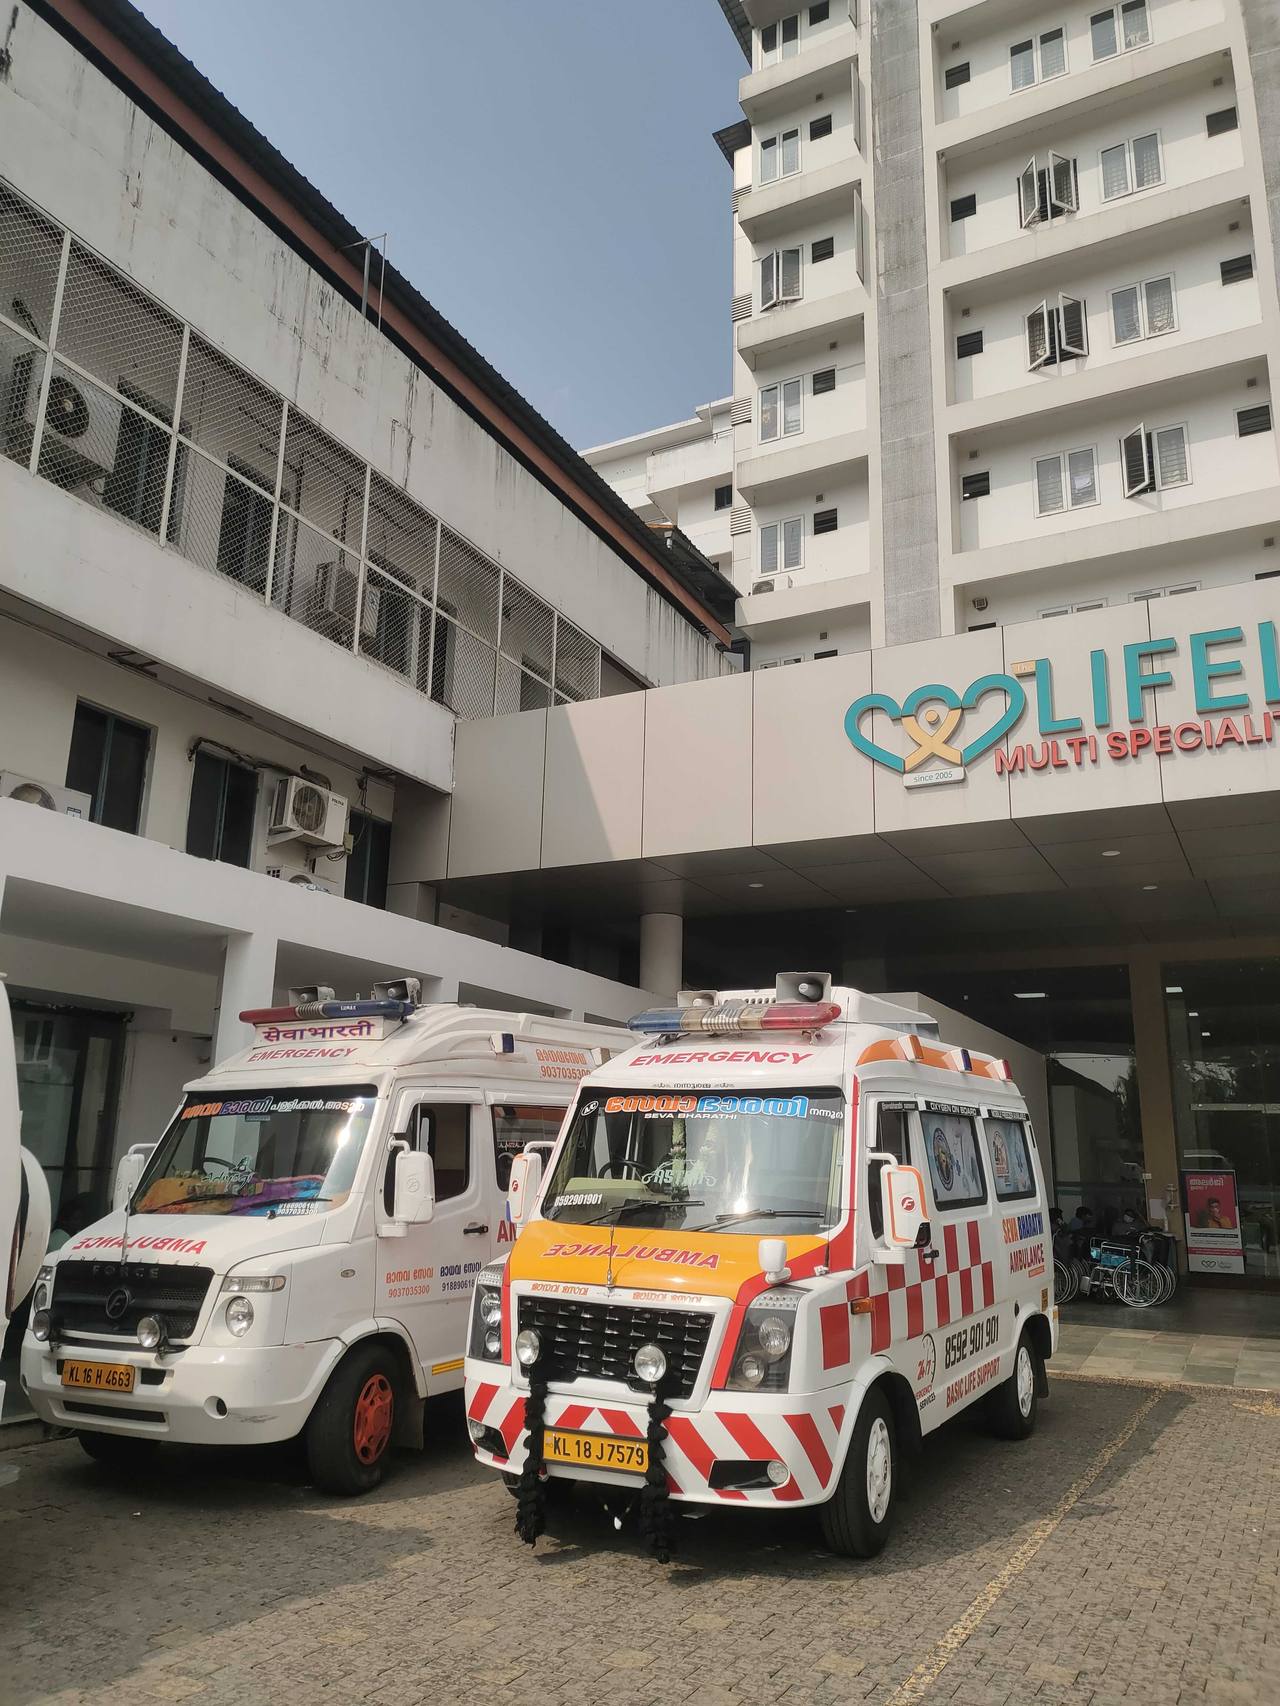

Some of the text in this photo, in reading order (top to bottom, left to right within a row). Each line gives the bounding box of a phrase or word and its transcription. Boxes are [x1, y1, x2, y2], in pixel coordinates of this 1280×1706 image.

[994, 710, 1280, 776] MULTI SPECIALI
[913, 771, 953, 783] since 2005
[247, 1047, 359, 1063] EMERGENCY
[628, 1051, 815, 1067] EMERGENCY
[677, 1112, 738, 1120] BHARATHI
[1009, 1243, 1045, 1274] AMBULANCE
[388, 1285, 430, 1298] 9037035300
[944, 1315, 1000, 1370] 8592 901 901
[68, 1366, 131, 1387] KL 16 H 4663
[946, 1356, 1001, 1409] BASIC LIFE SUPPORT
[553, 1435, 571, 1457] KL
[575, 1439, 592, 1459] 18
[607, 1443, 644, 1466] 7579
